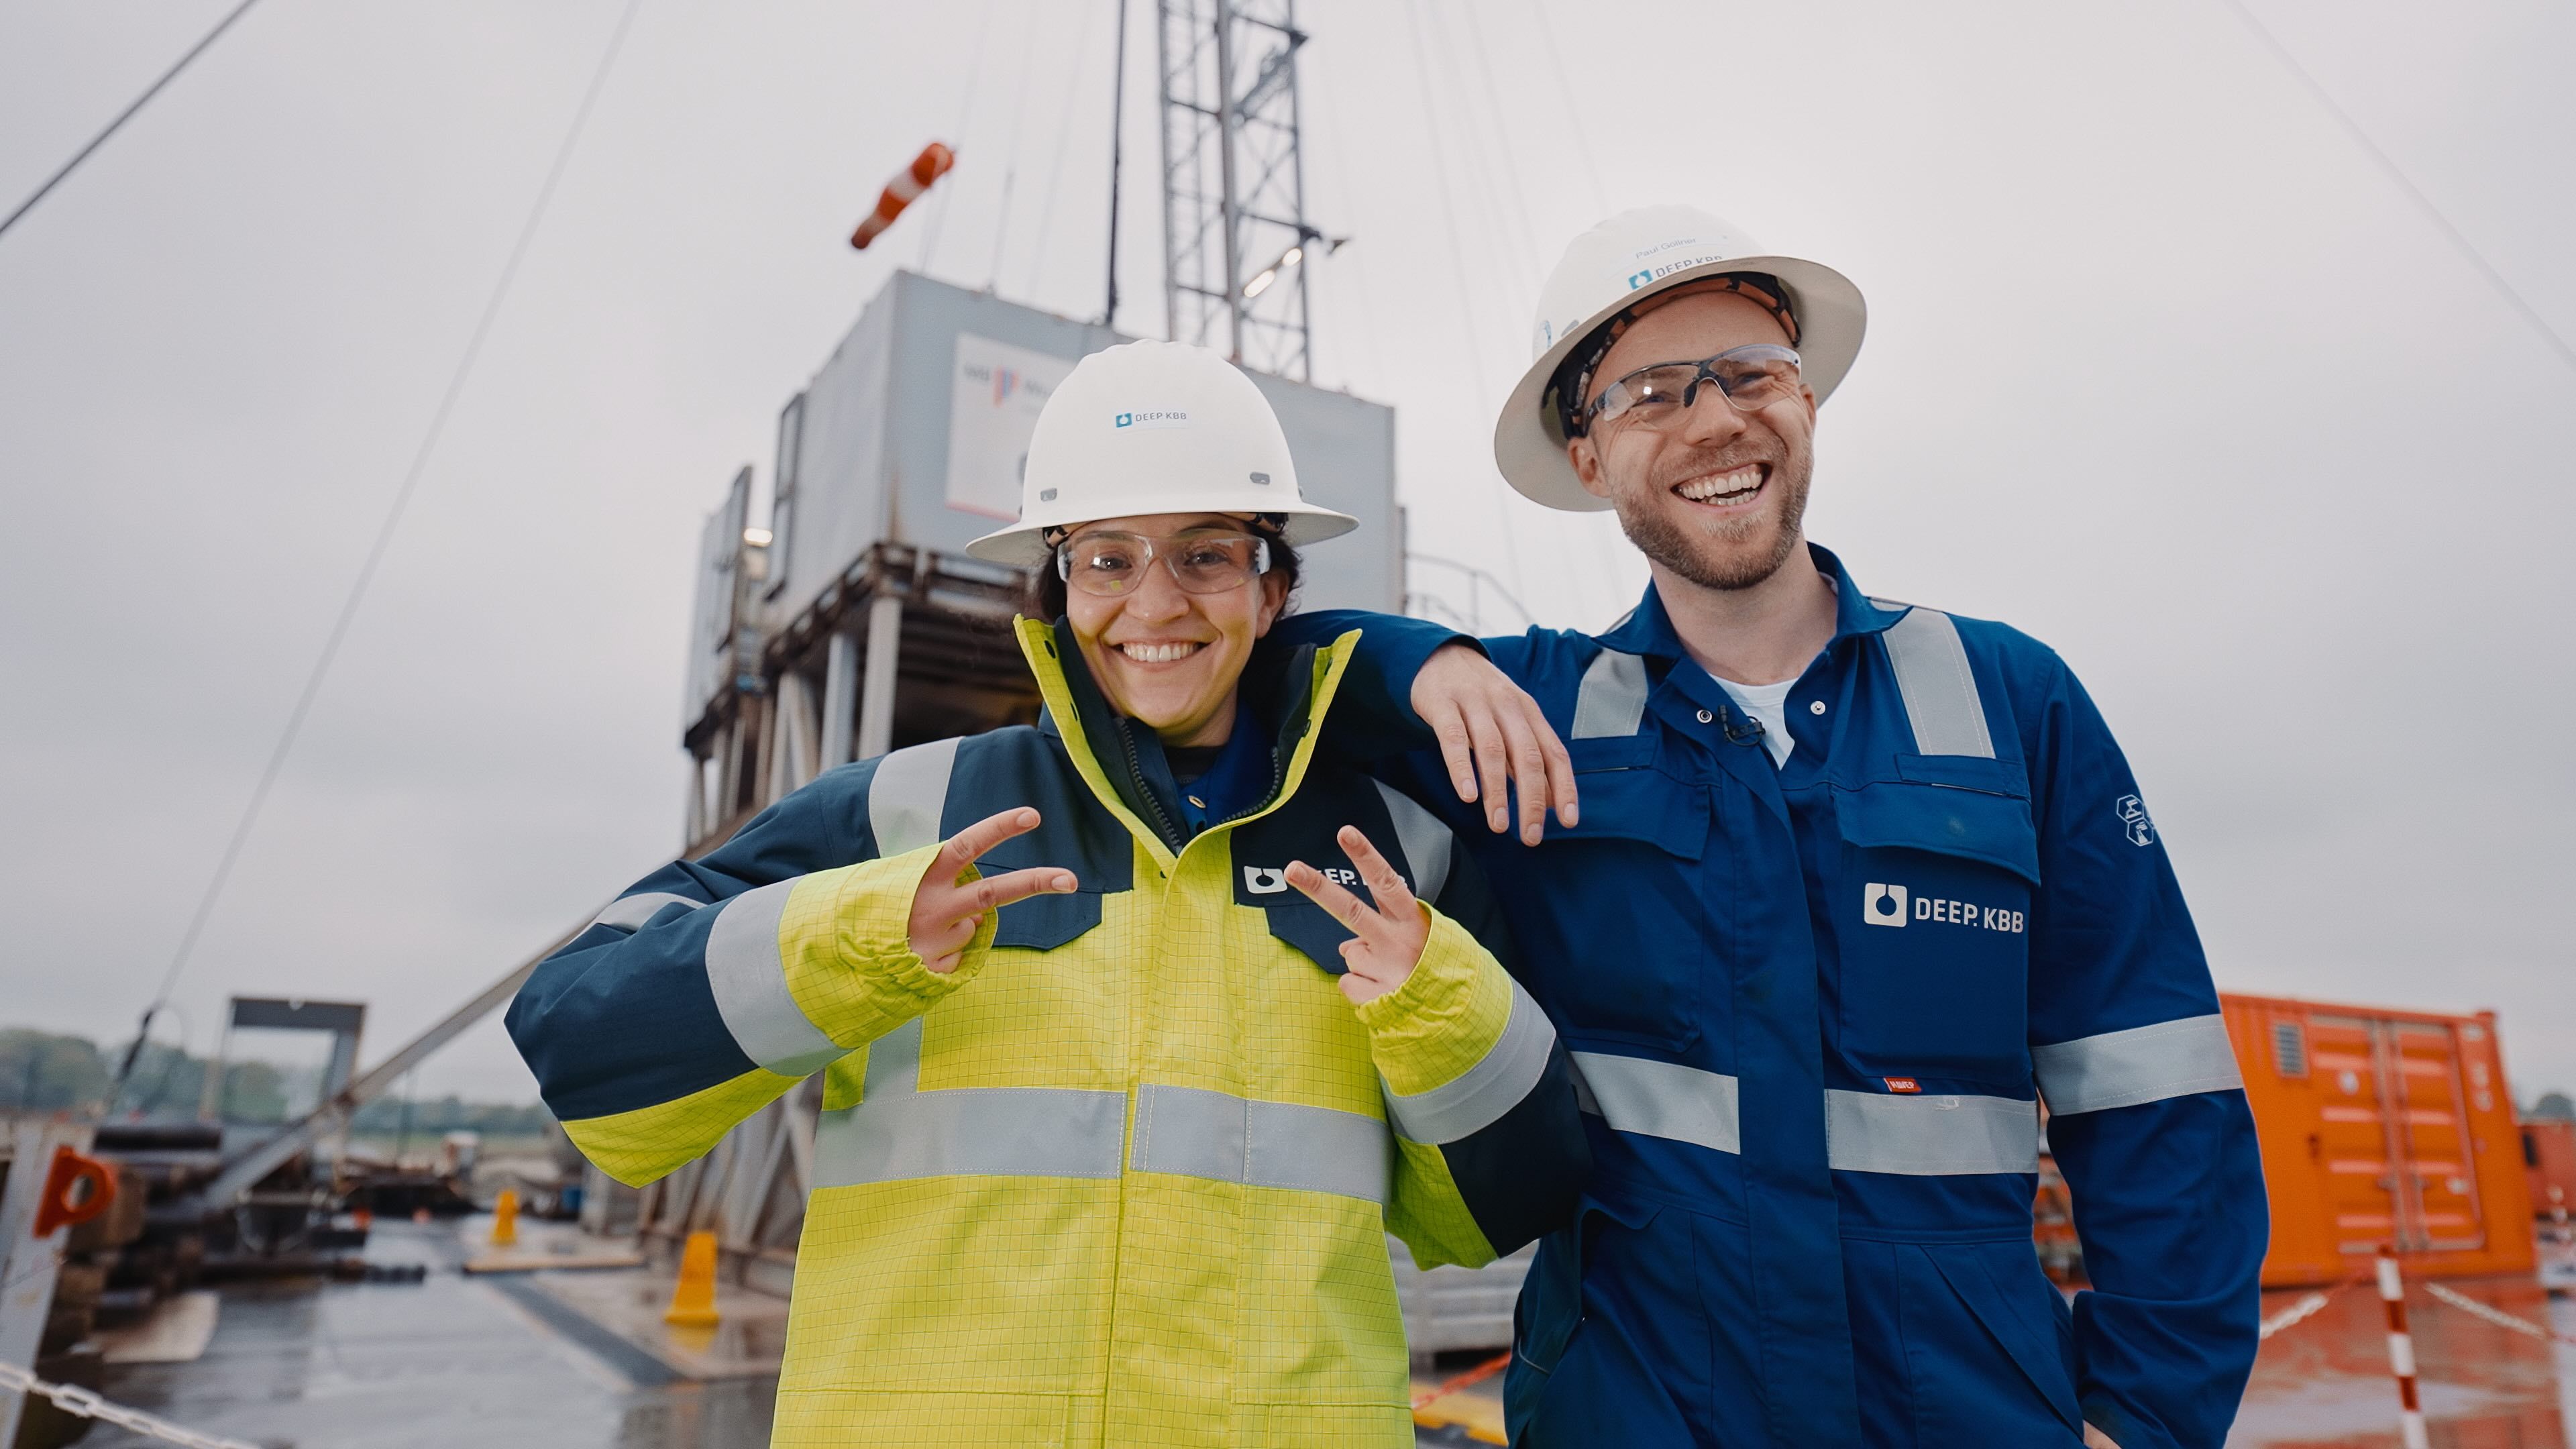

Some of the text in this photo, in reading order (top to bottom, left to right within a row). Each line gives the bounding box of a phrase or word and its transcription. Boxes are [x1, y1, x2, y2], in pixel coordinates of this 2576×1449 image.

[1635, 247, 1658, 258] Paul
[1136, 412, 1187, 421] DEEP KBB
[1915, 898, 2024, 933] DEEP. KBB
